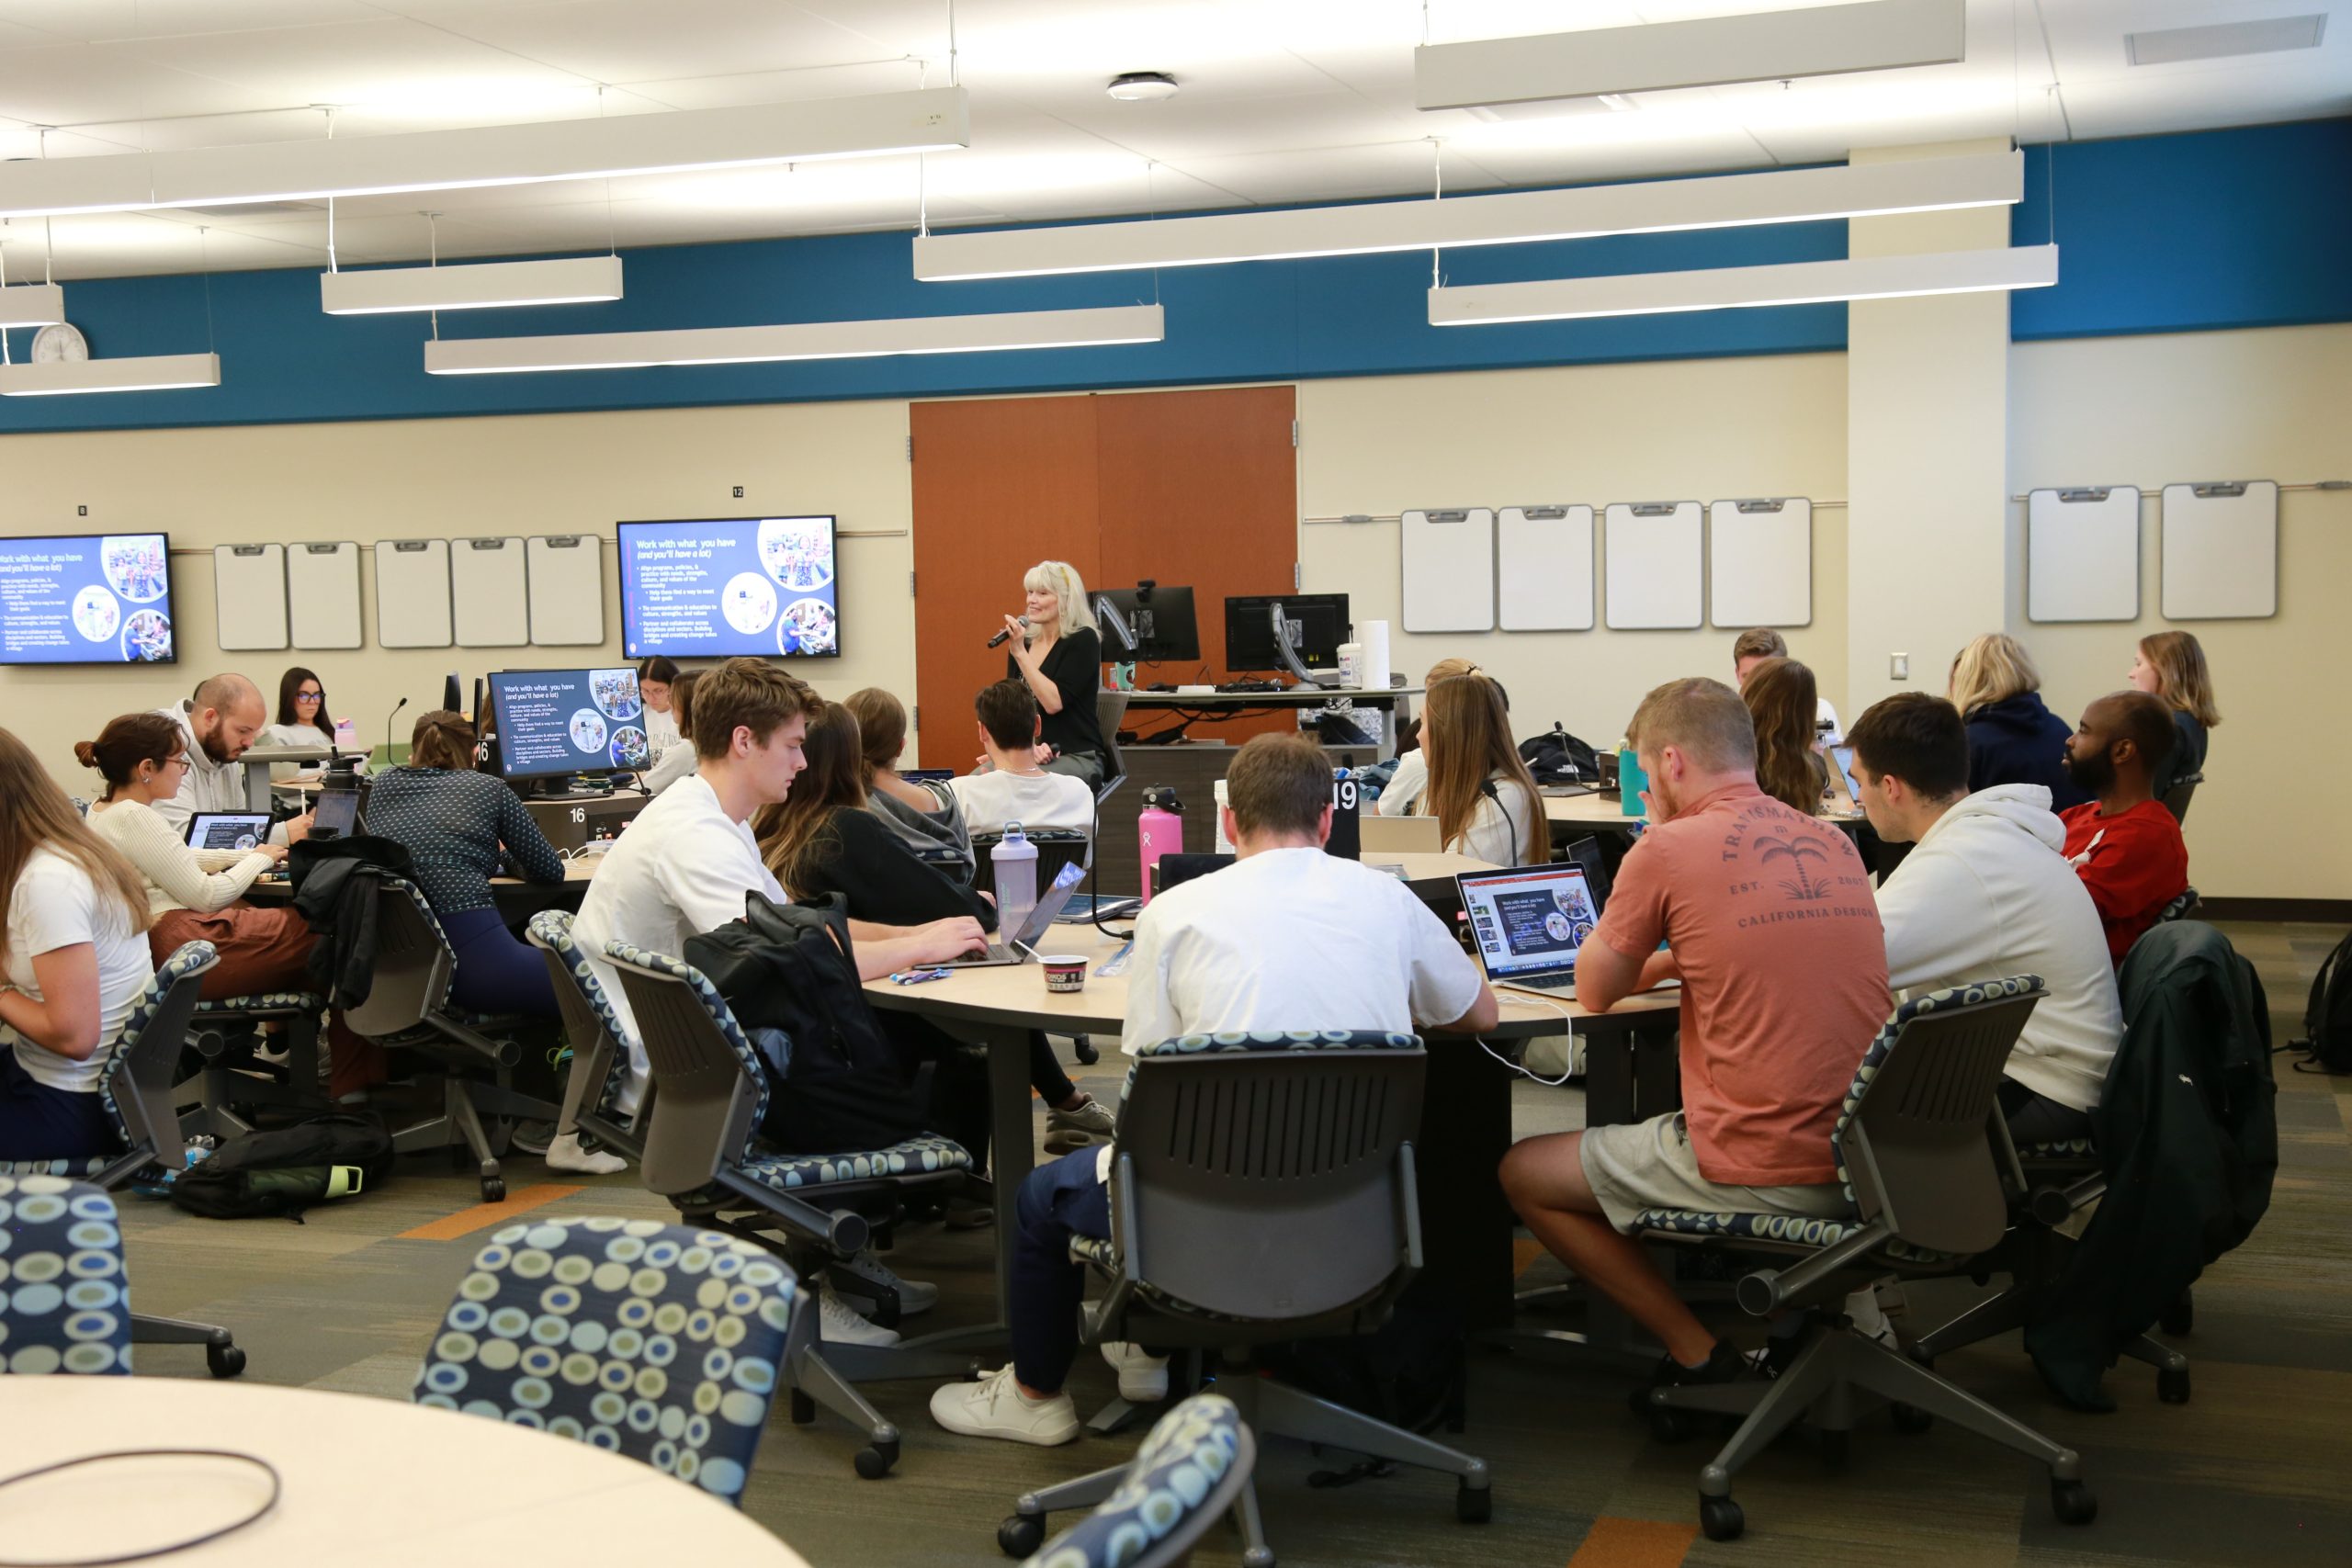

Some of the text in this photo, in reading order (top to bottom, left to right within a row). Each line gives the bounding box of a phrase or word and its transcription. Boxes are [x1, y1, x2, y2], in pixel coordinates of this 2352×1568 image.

[636, 540, 657, 549] Work
[658, 539, 676, 548] with
[677, 539, 697, 548] what
[717, 538, 736, 547] have
[637, 551, 653, 560] (and
[654, 550, 673, 560] you'll
[699, 550, 711, 559] lot)
[477, 741, 489, 761] 16
[1333, 781, 1357, 810] 19
[570, 807, 585, 823] 16
[1729, 881, 1764, 895] EST.
[1738, 907, 1875, 928] CALIFORNIA DESIGN
